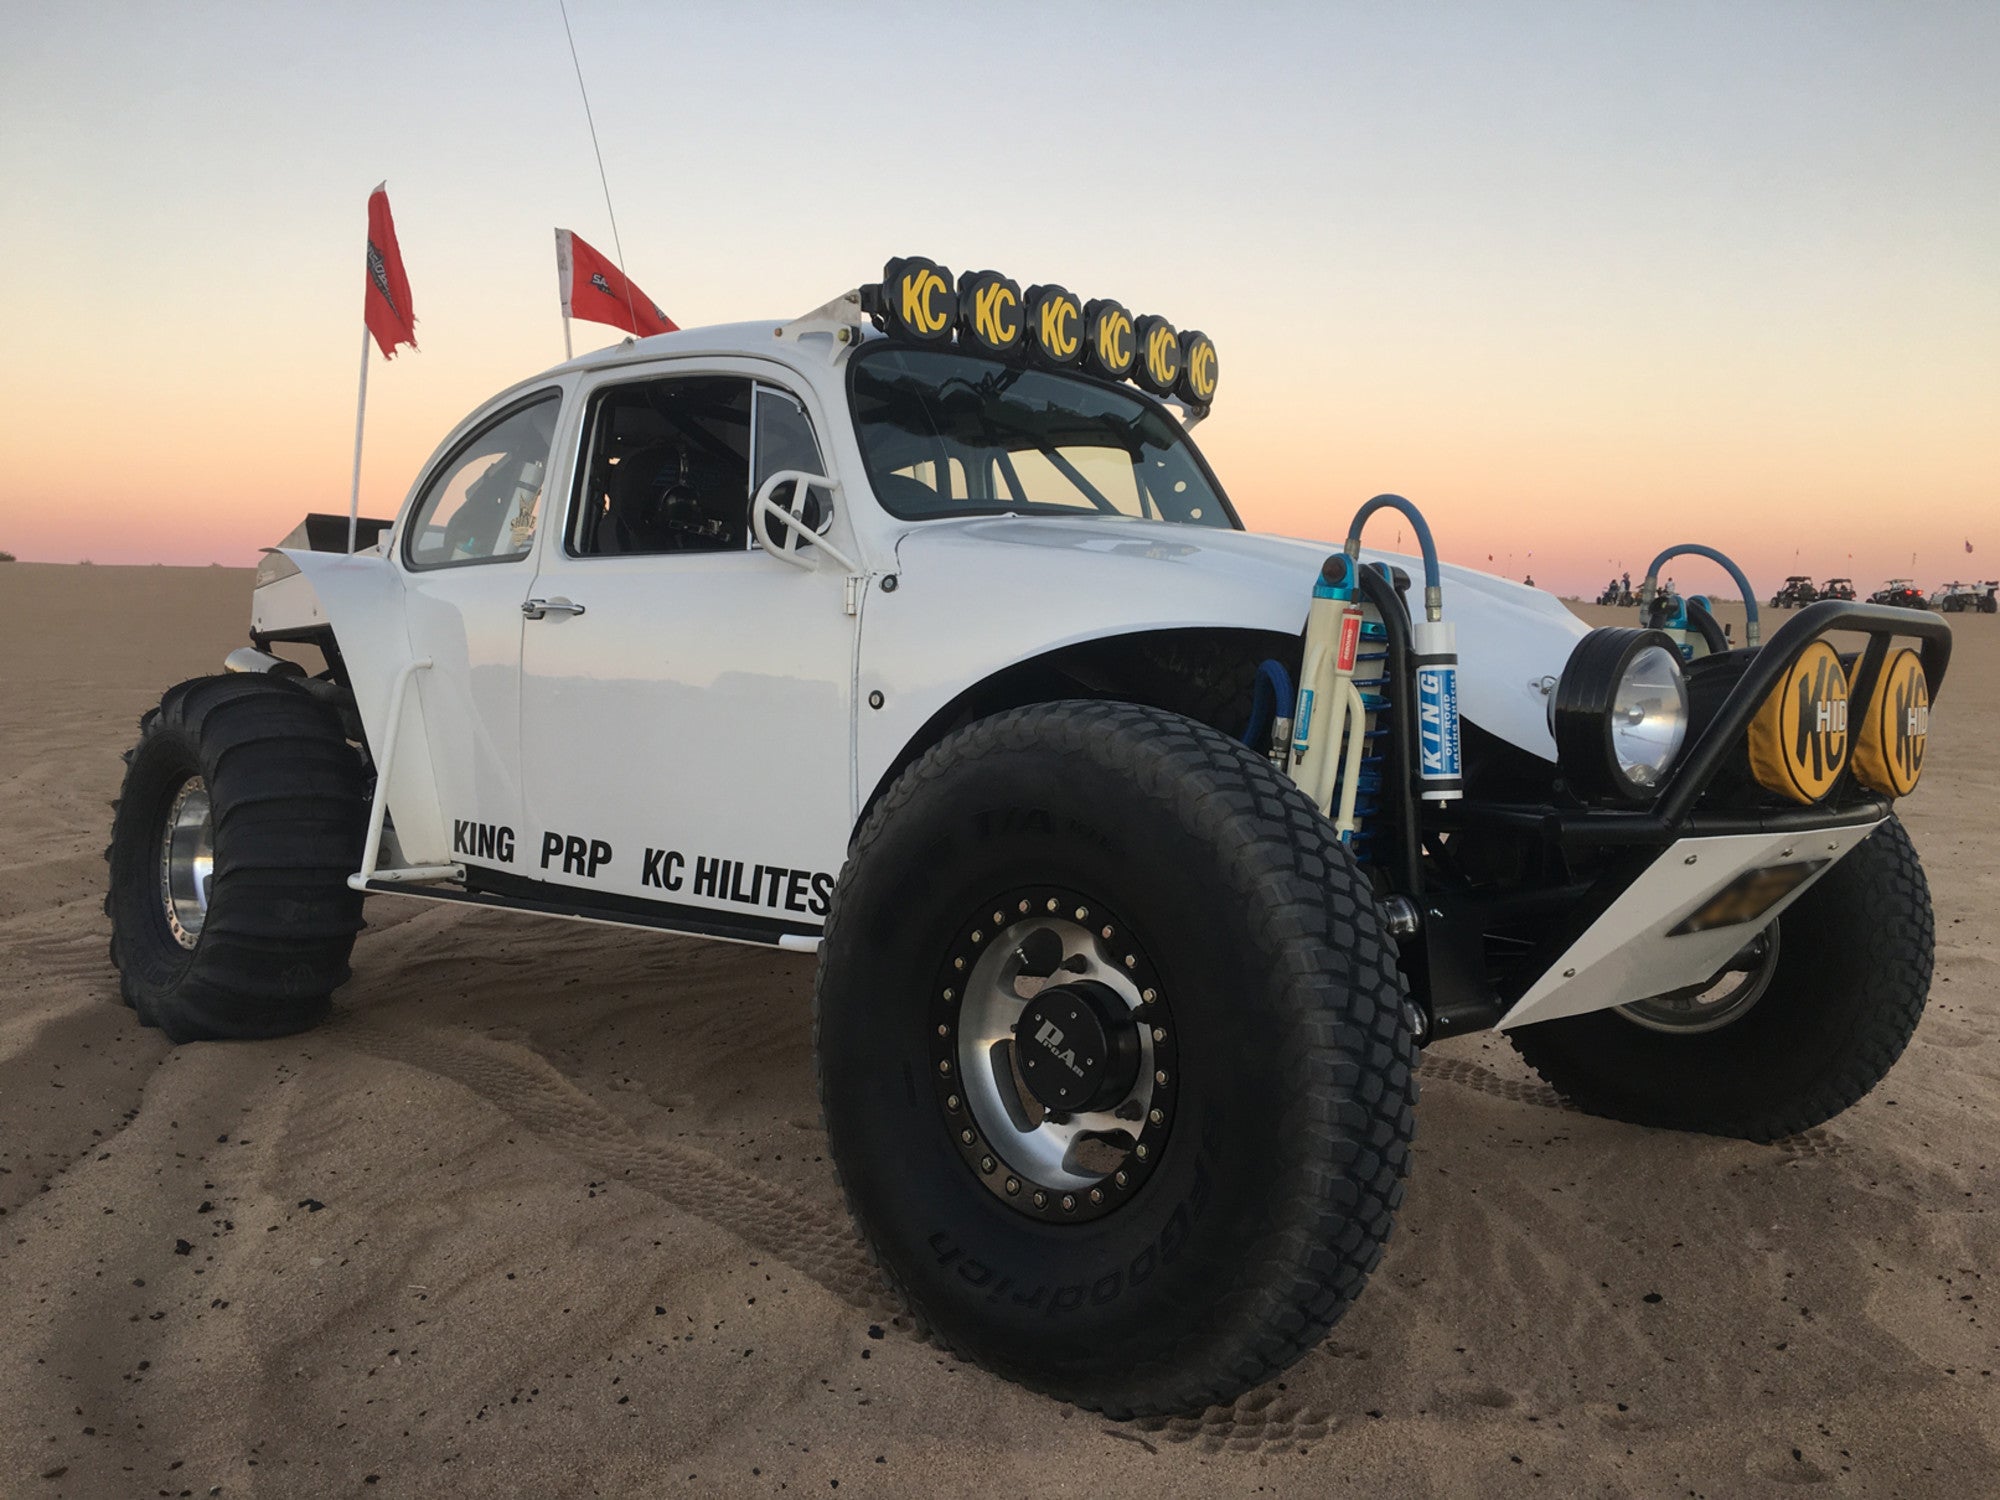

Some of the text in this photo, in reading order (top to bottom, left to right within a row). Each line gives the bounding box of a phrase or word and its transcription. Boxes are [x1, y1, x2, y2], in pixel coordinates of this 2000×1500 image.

[902, 269, 947, 333] KC
[975, 282, 1016, 345] KC
[1041, 296, 1077, 356] KC
[1099, 311, 1131, 368] KC
[1149, 326, 1176, 382] KC
[1191, 342, 1215, 396] KC
[1421, 673, 1441, 770] KING
[1796, 655, 1846, 782] KC
[1816, 699, 1847, 734] HID
[1896, 666, 1926, 782] KC
[1907, 706, 1929, 736] HID
[453, 819, 515, 864] KING
[540, 831, 613, 879] PRP
[641, 847, 838, 917] KC HILITES
